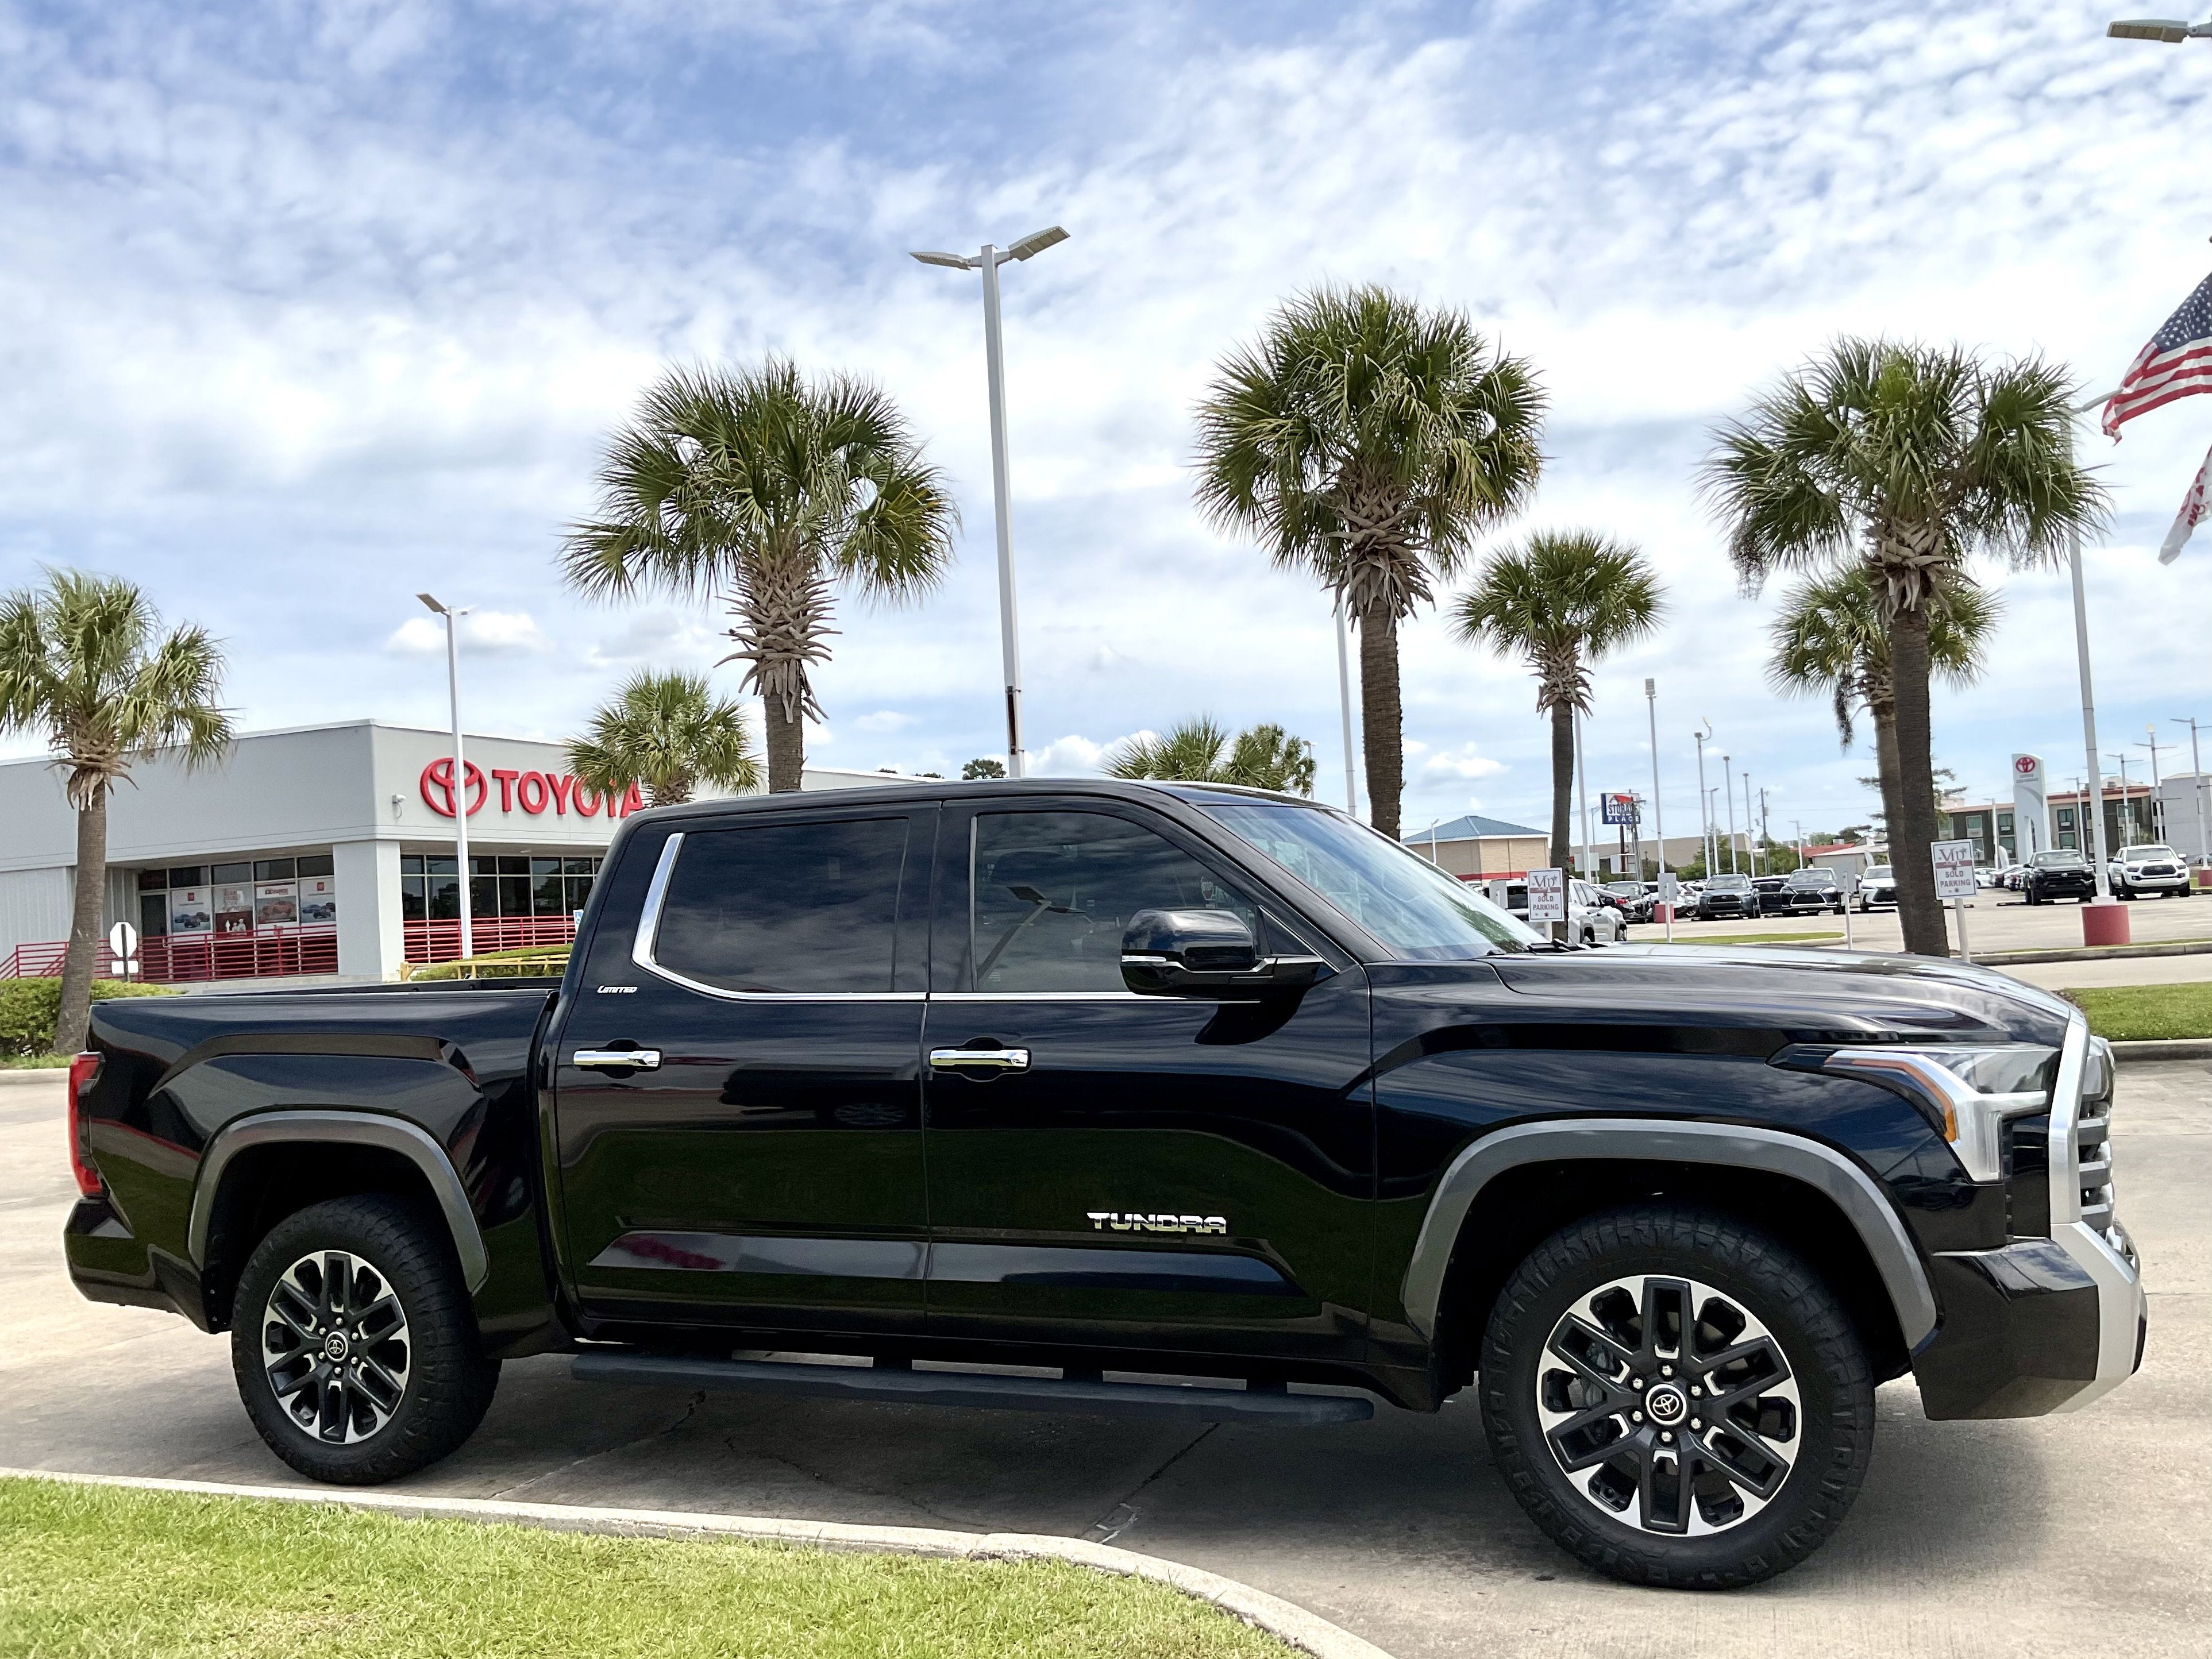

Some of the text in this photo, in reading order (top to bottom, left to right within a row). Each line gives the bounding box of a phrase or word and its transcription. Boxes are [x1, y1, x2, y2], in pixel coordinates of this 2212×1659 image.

[1609, 804, 1639, 815] STORA
[1940, 879, 1971, 888] PARKING
[1087, 1212, 1226, 1234] TUNDRA
